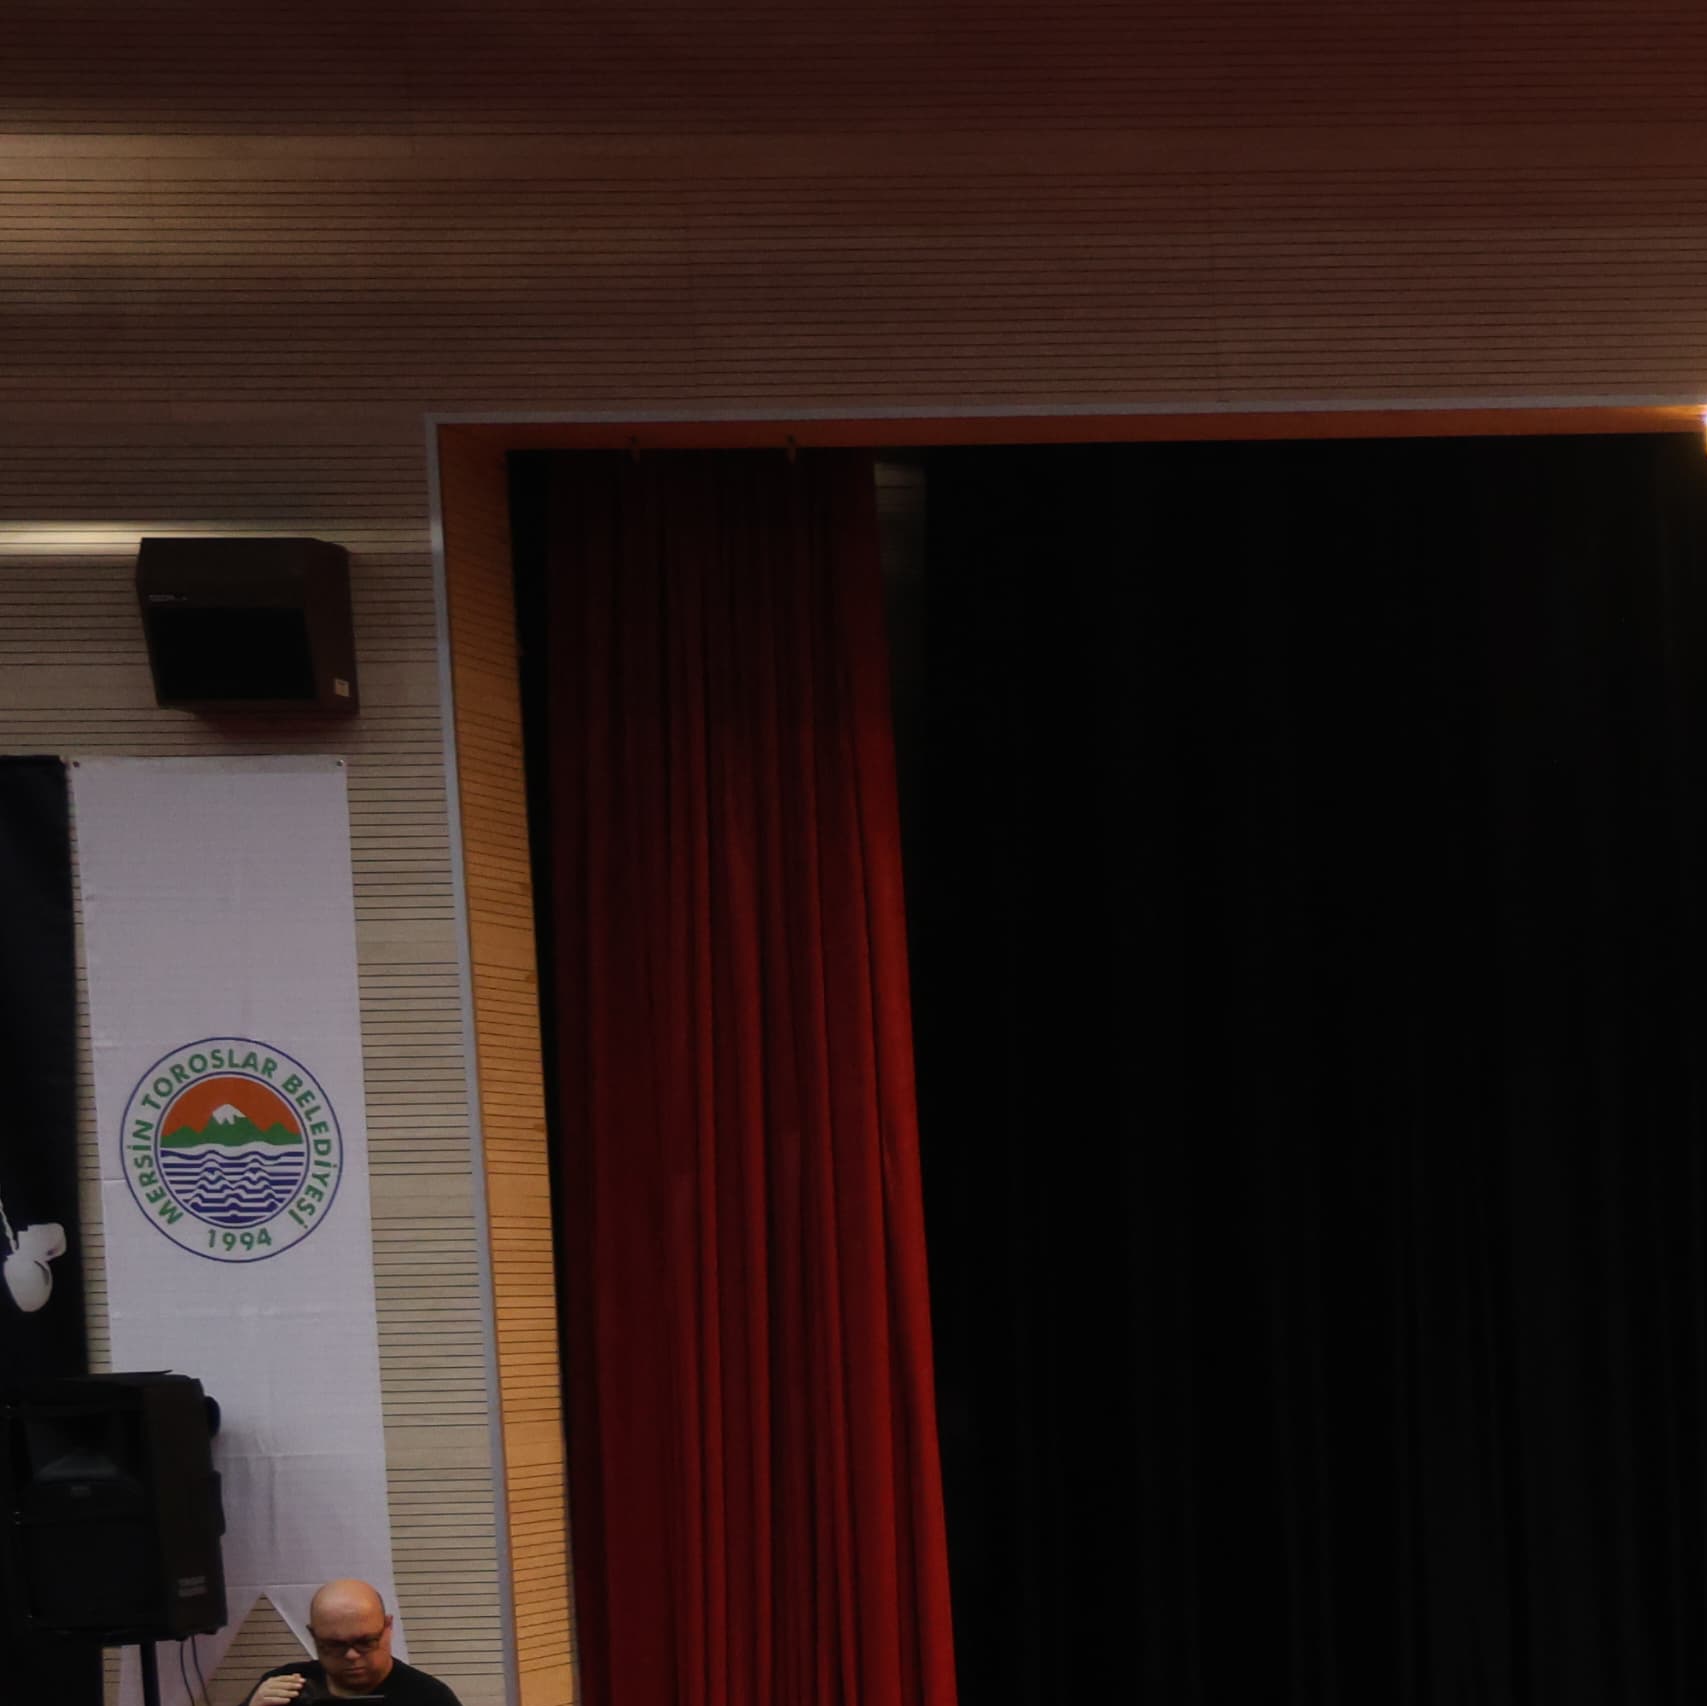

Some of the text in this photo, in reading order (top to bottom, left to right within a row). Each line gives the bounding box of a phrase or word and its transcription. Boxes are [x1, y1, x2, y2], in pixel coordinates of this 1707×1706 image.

[127, 1048, 338, 1229] MERSİN TOROSLAR BELEDİYESİ
[207, 1227, 273, 1252] 1994
